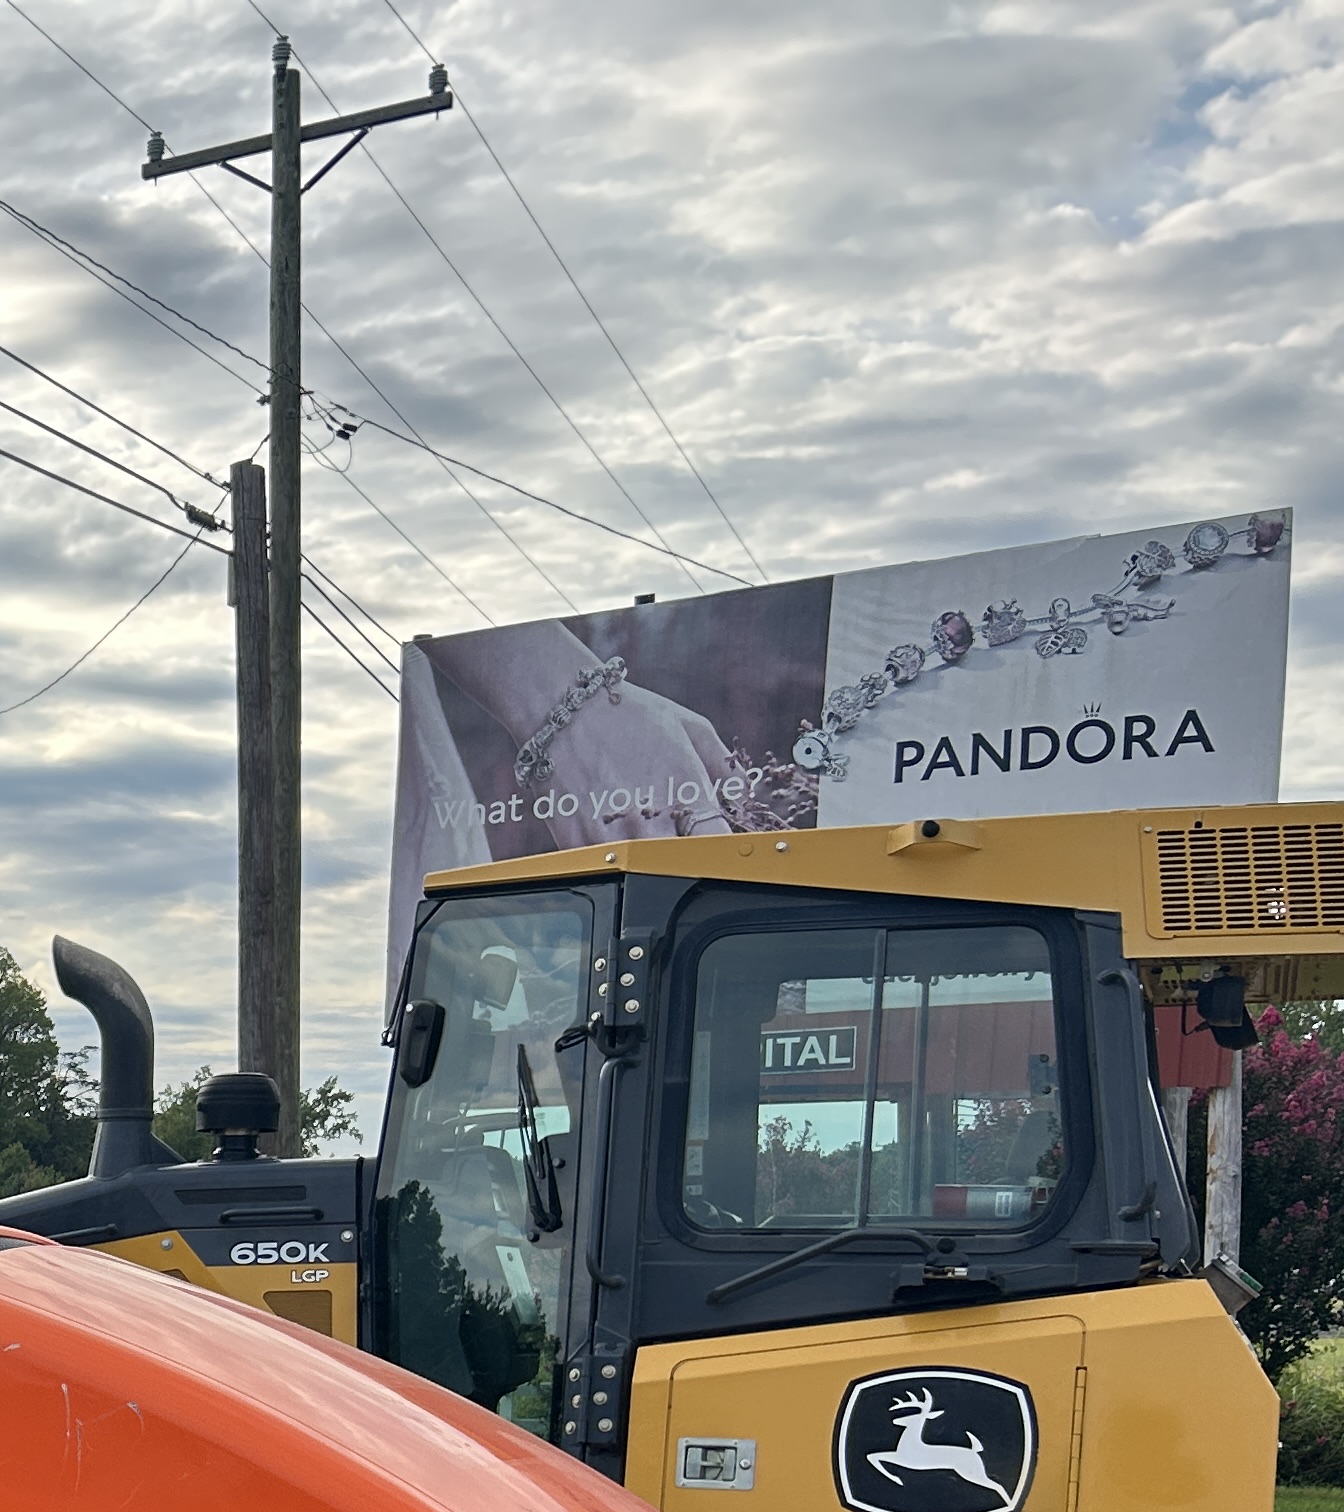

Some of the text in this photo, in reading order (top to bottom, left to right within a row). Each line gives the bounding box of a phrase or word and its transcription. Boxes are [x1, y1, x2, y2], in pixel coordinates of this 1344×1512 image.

[893, 705, 1216, 784] PANDORA
[434, 767, 763, 830] What do you love?
[760, 1034, 851, 1068] ITAL
[230, 1240, 330, 1265] 650K
[291, 1269, 330, 1283] LGP
